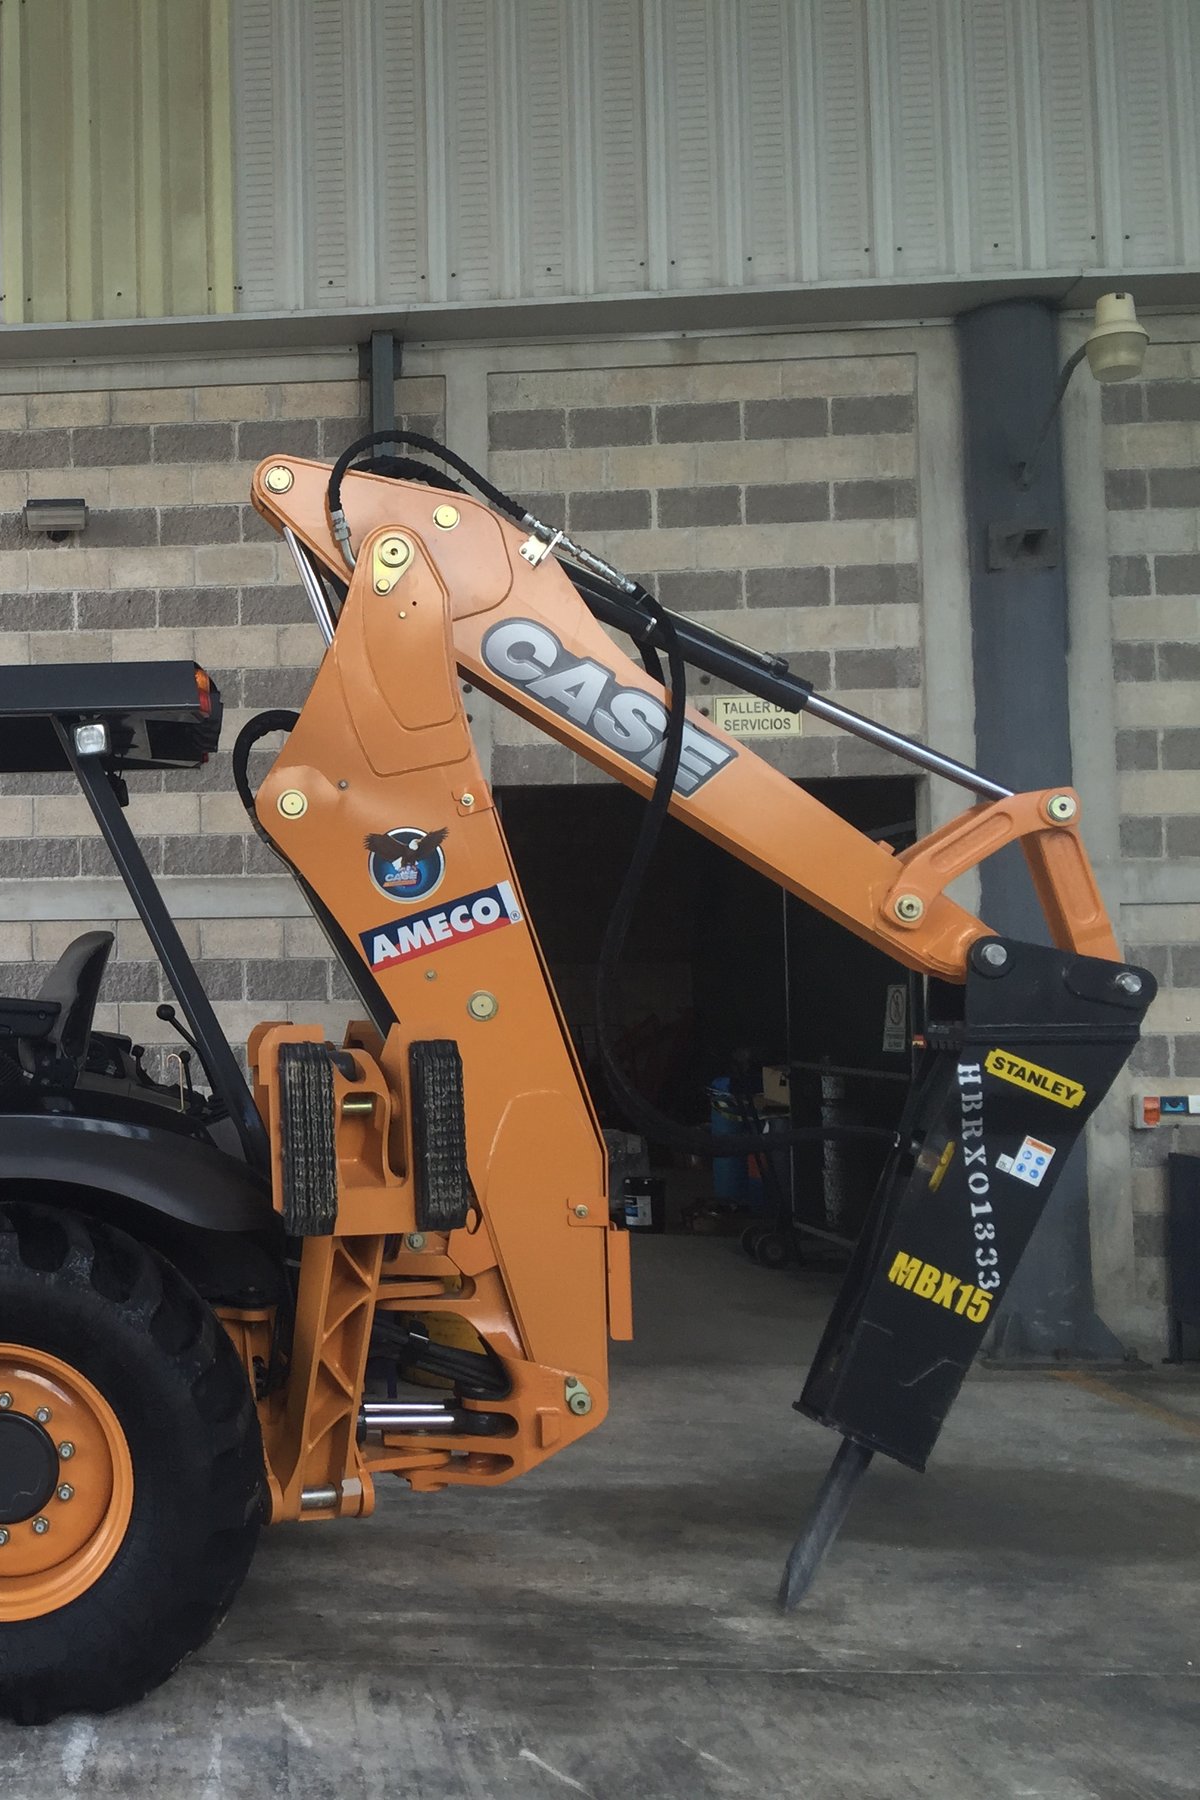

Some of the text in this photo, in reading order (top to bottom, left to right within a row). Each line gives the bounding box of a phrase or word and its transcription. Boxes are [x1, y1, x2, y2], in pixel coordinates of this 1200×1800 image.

[483, 621, 734, 794] CASE
[723, 702, 771, 714] TALLER
[724, 718, 791, 731] SERVICIOS
[373, 897, 501, 964] AMECO
[992, 1056, 1079, 1101] STANLEY
[888, 1250, 994, 1323] MBX15
